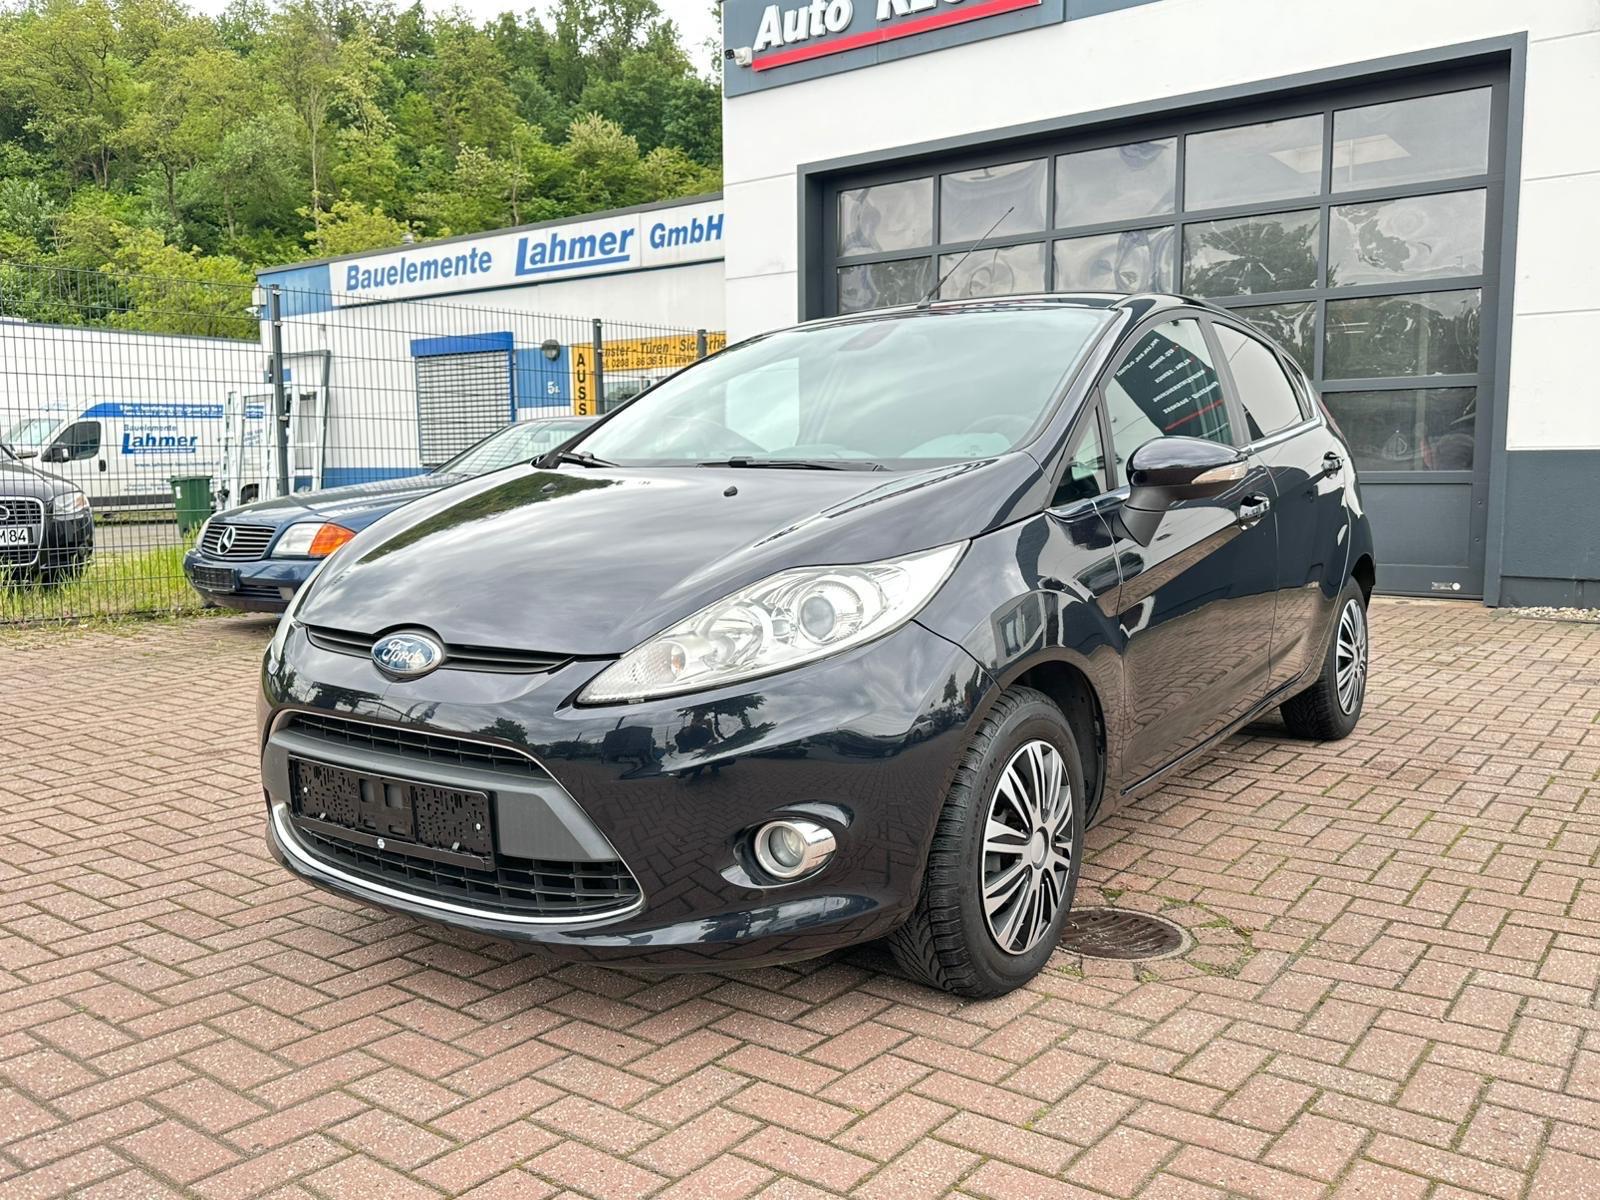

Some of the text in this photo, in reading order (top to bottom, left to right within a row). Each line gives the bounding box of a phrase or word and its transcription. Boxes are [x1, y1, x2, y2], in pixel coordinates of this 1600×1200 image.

[752, 0, 853, 51] Auto
[346, 213, 724, 291] Bauelemente Lahmer GmbH
[576, 353, 588, 416] AUSS
[121, 433, 198, 454] Lahmer
[381, 639, 421, 663] Ford
